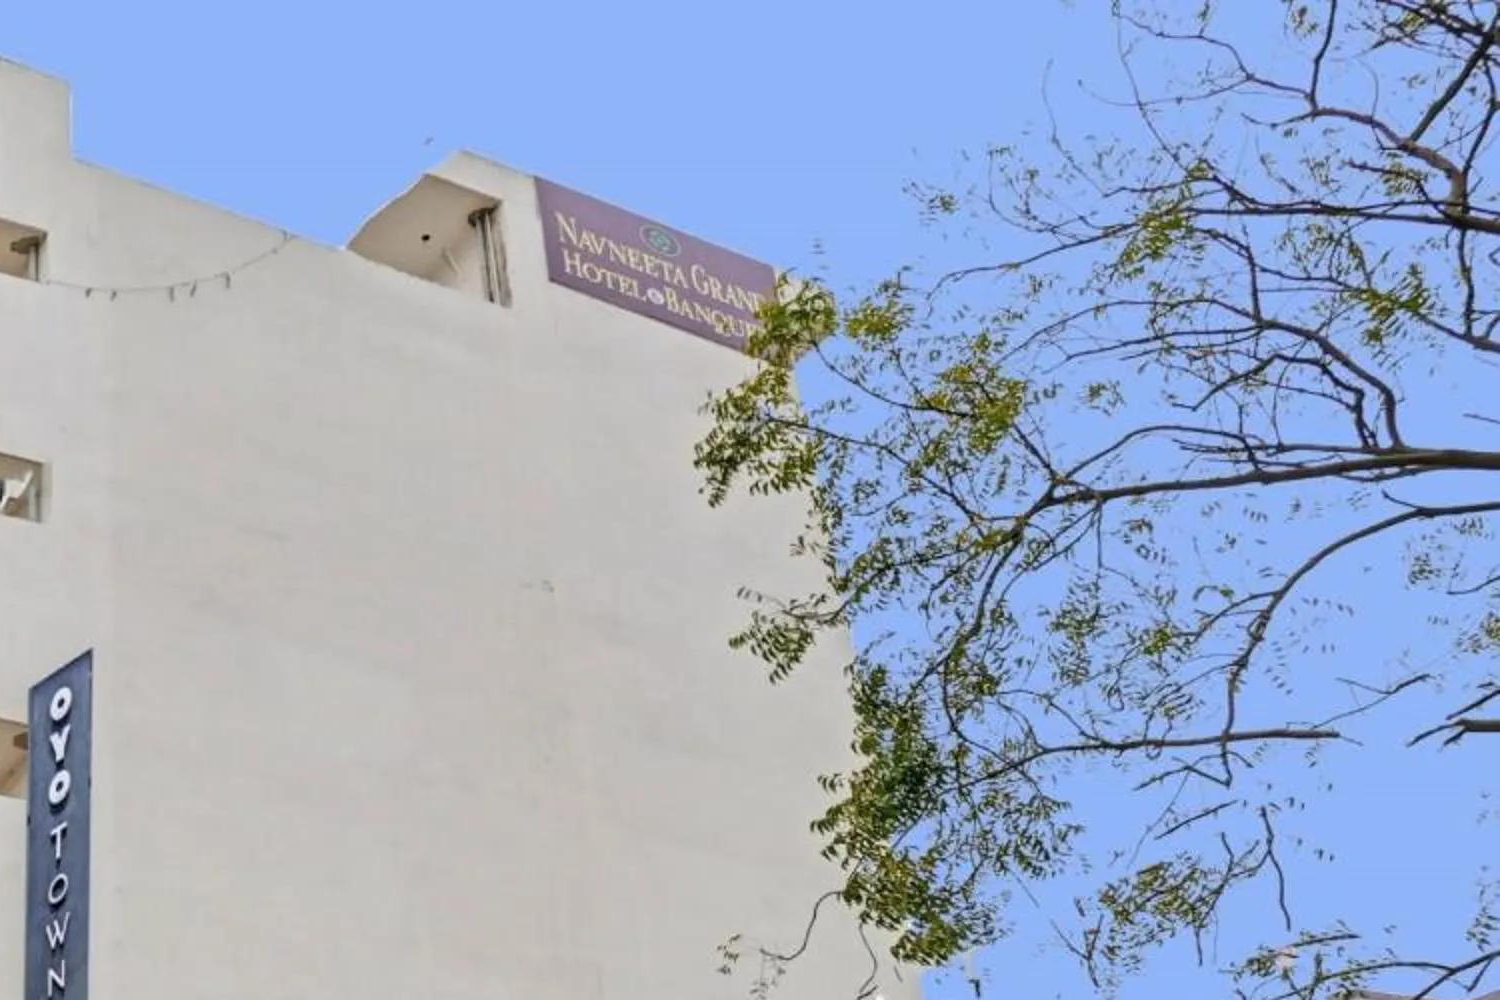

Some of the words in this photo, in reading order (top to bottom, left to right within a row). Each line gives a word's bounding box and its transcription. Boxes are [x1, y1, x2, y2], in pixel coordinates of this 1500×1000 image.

[554, 210, 689, 290] NAVNEETA
[562, 247, 647, 303] HOTEL
[49, 686, 73, 805] OYO
